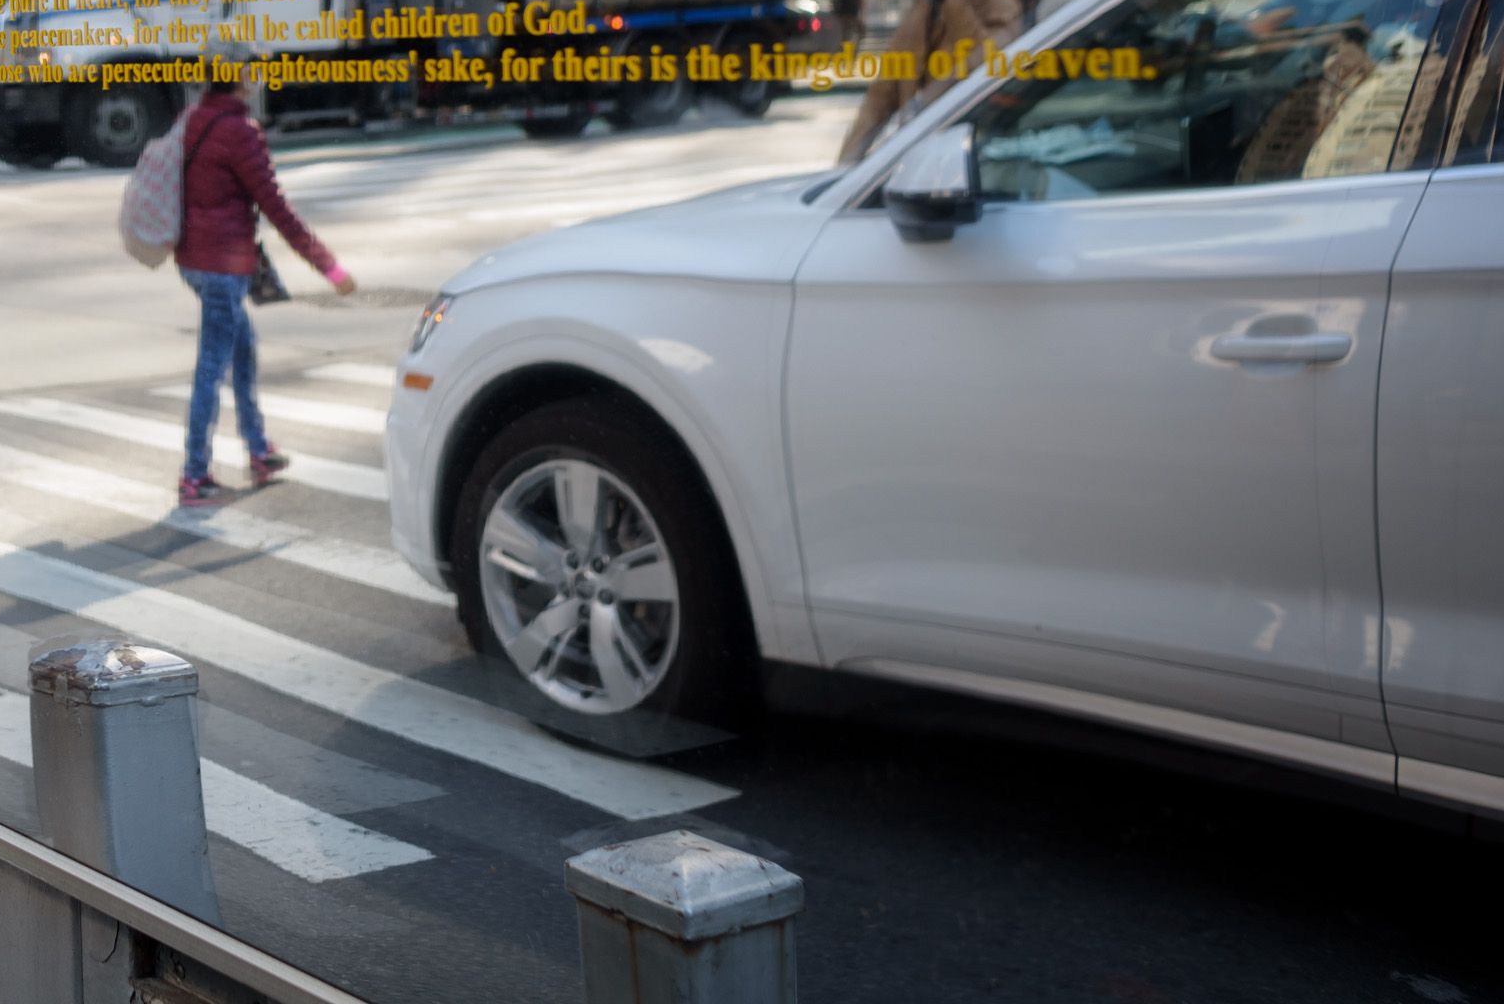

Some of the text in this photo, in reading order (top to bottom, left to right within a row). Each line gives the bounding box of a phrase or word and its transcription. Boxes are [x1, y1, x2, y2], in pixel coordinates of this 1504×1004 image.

[10, 21, 129, 53] peacemakers,
[134, 18, 162, 45] for
[168, 18, 210, 50] they
[218, 14, 256, 42] will
[262, 14, 289, 41] be
[296, 9, 364, 40] called
[371, 6, 479, 40] children
[488, 2, 518, 36] of
[523, 0, 596, 35] God.
[29, 59, 63, 82] who
[68, 63, 98, 83] are
[102, 54, 206, 90] persecuted
[212, 54, 244, 83] for
[250, 50, 418, 90] righteousness'
[424, 50, 494, 89] sake,
[501, 48, 545, 82] for
[552, 46, 642, 82] theirs
[650, 46, 678, 82] is
[686, 45, 742, 82] the
[750, 40, 917, 92] kingdom
[928, 38, 975, 80] of
[983, 39, 1157, 80] heaven.
